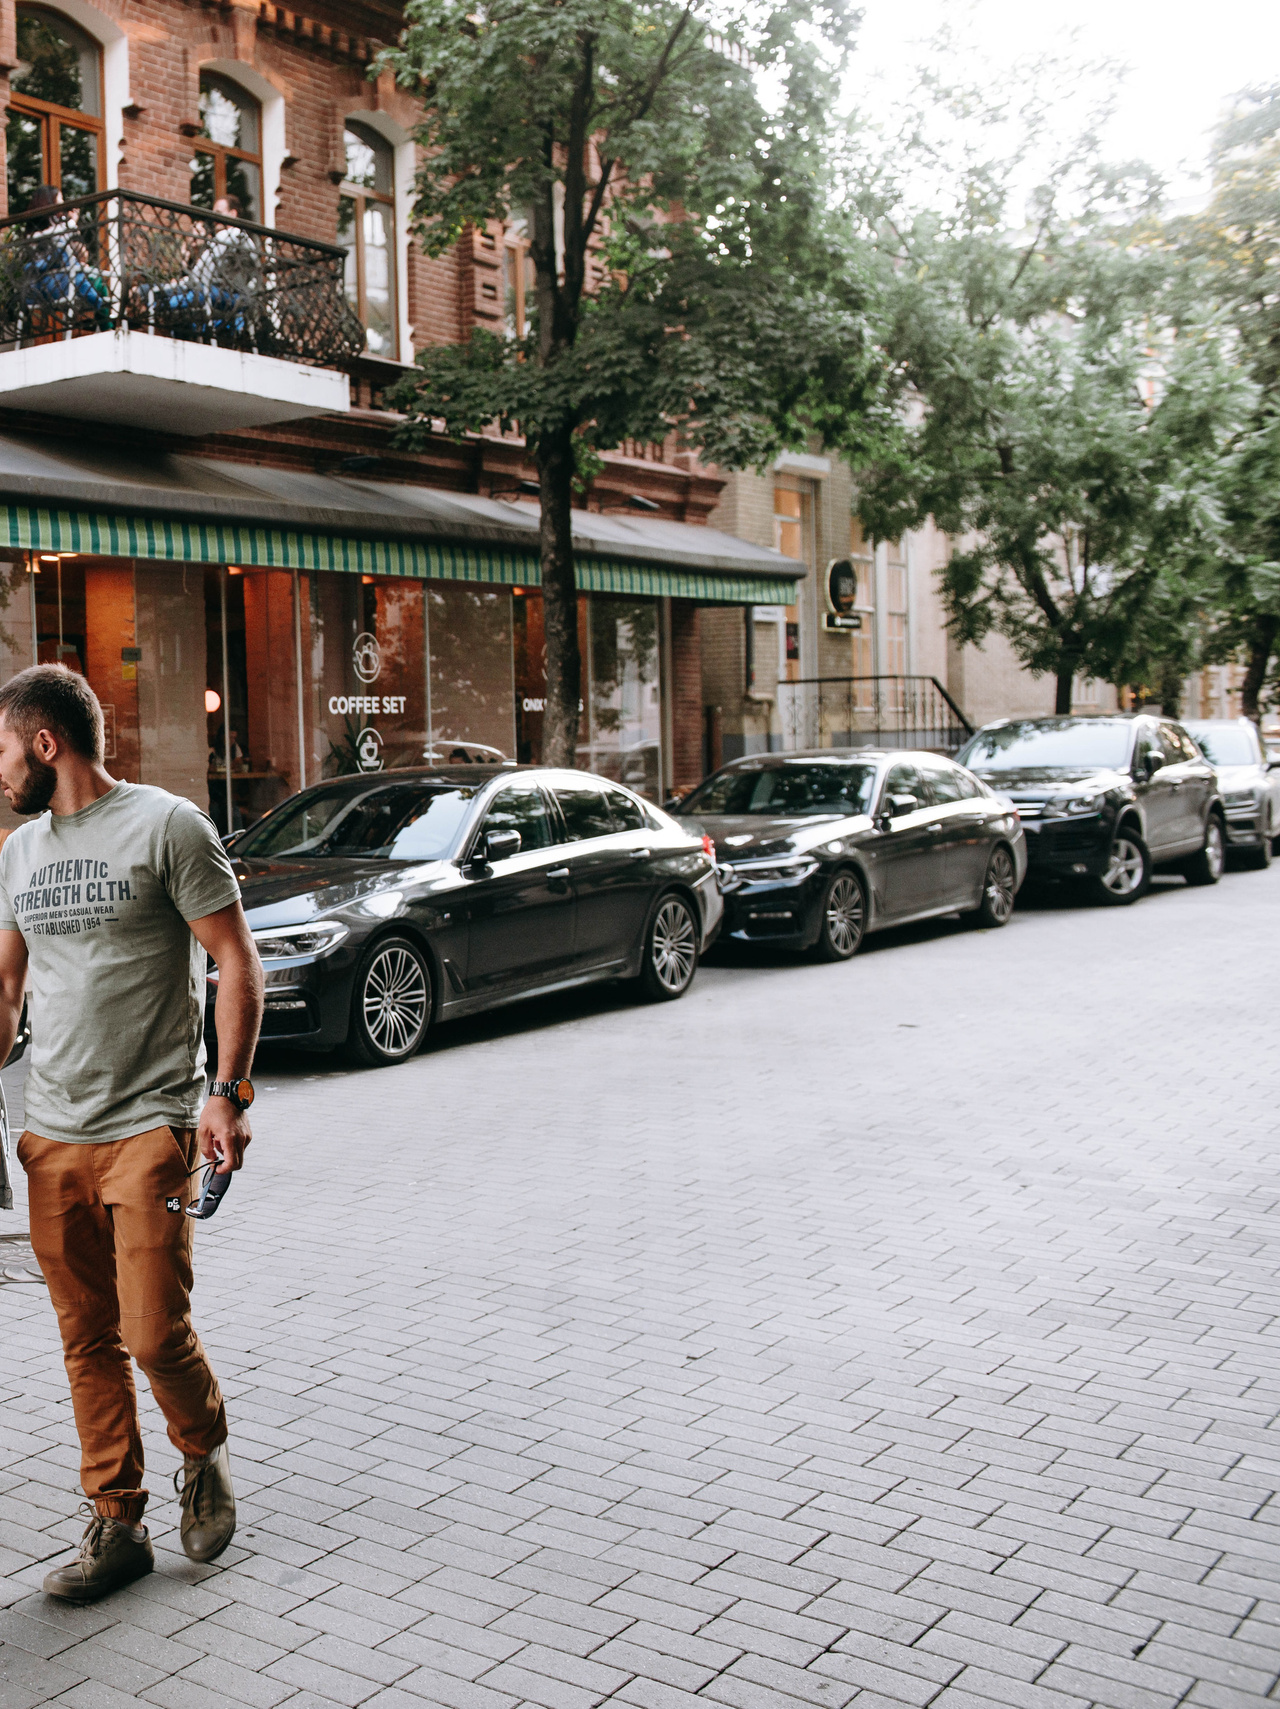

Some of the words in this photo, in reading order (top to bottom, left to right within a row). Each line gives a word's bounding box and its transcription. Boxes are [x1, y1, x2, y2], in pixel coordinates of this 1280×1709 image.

[328, 696, 380, 715] COFFEE
[382, 696, 407, 714] SET
[29, 859, 108, 889] AUTHENTIC
[14, 883, 81, 915] STRENGTH
[86, 880, 138, 903] CLTH.
[24, 911, 48, 924] SUPERIOR
[48, 909, 68, 920] MEN'S
[68, 906, 93, 918] CASUAL
[93, 905, 115, 915] WEAR
[33, 920, 81, 936] ESTABLISHED
[82, 917, 102, 931] 1954
